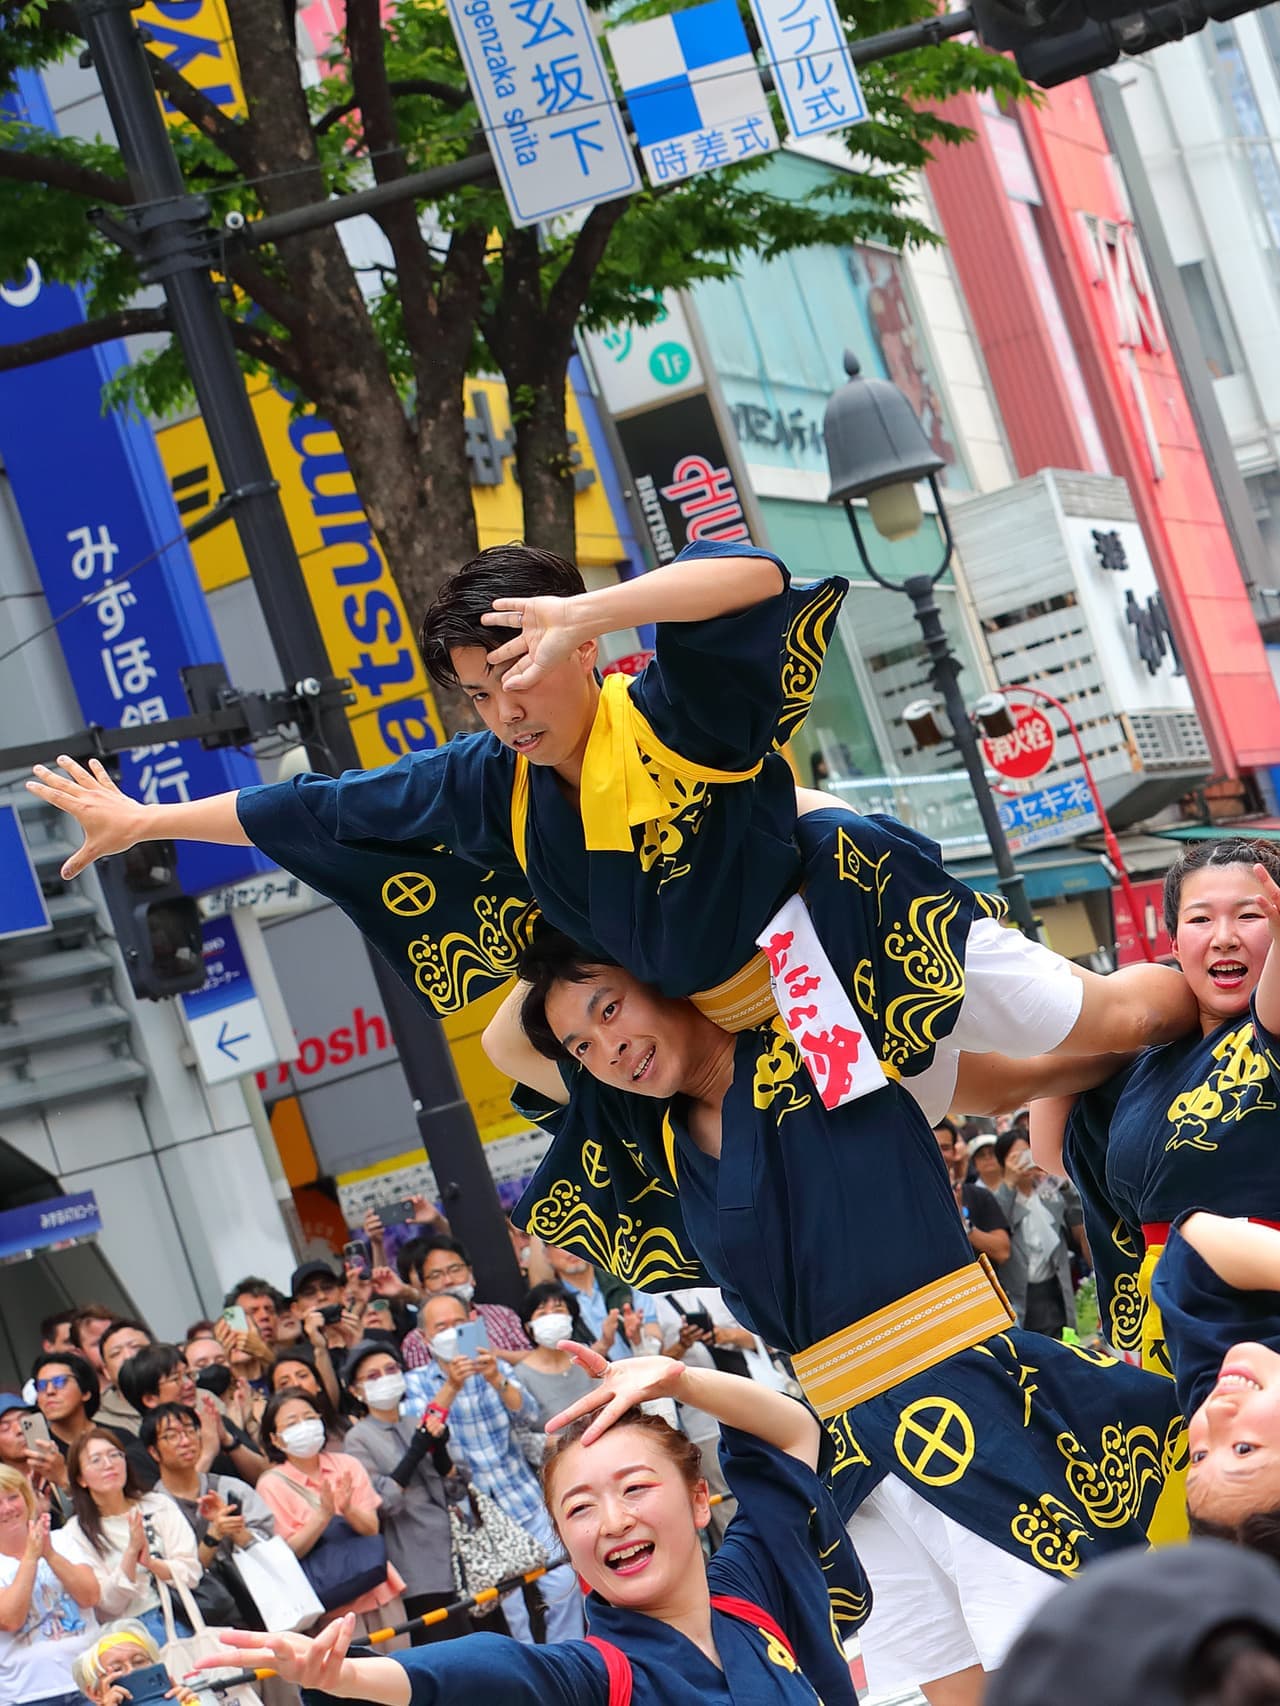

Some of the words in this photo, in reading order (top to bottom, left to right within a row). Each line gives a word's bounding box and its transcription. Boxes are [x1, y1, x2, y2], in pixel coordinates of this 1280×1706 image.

[503, 107, 538, 166] shita
[651, 117, 769, 181] 時差式
[658, 352, 684, 378] 1F
[635, 474, 676, 561] BRITISH
[660, 455, 753, 546] HU
[67, 525, 190, 805] みずほ銀行
[984, 717, 1052, 767] 消火栓
